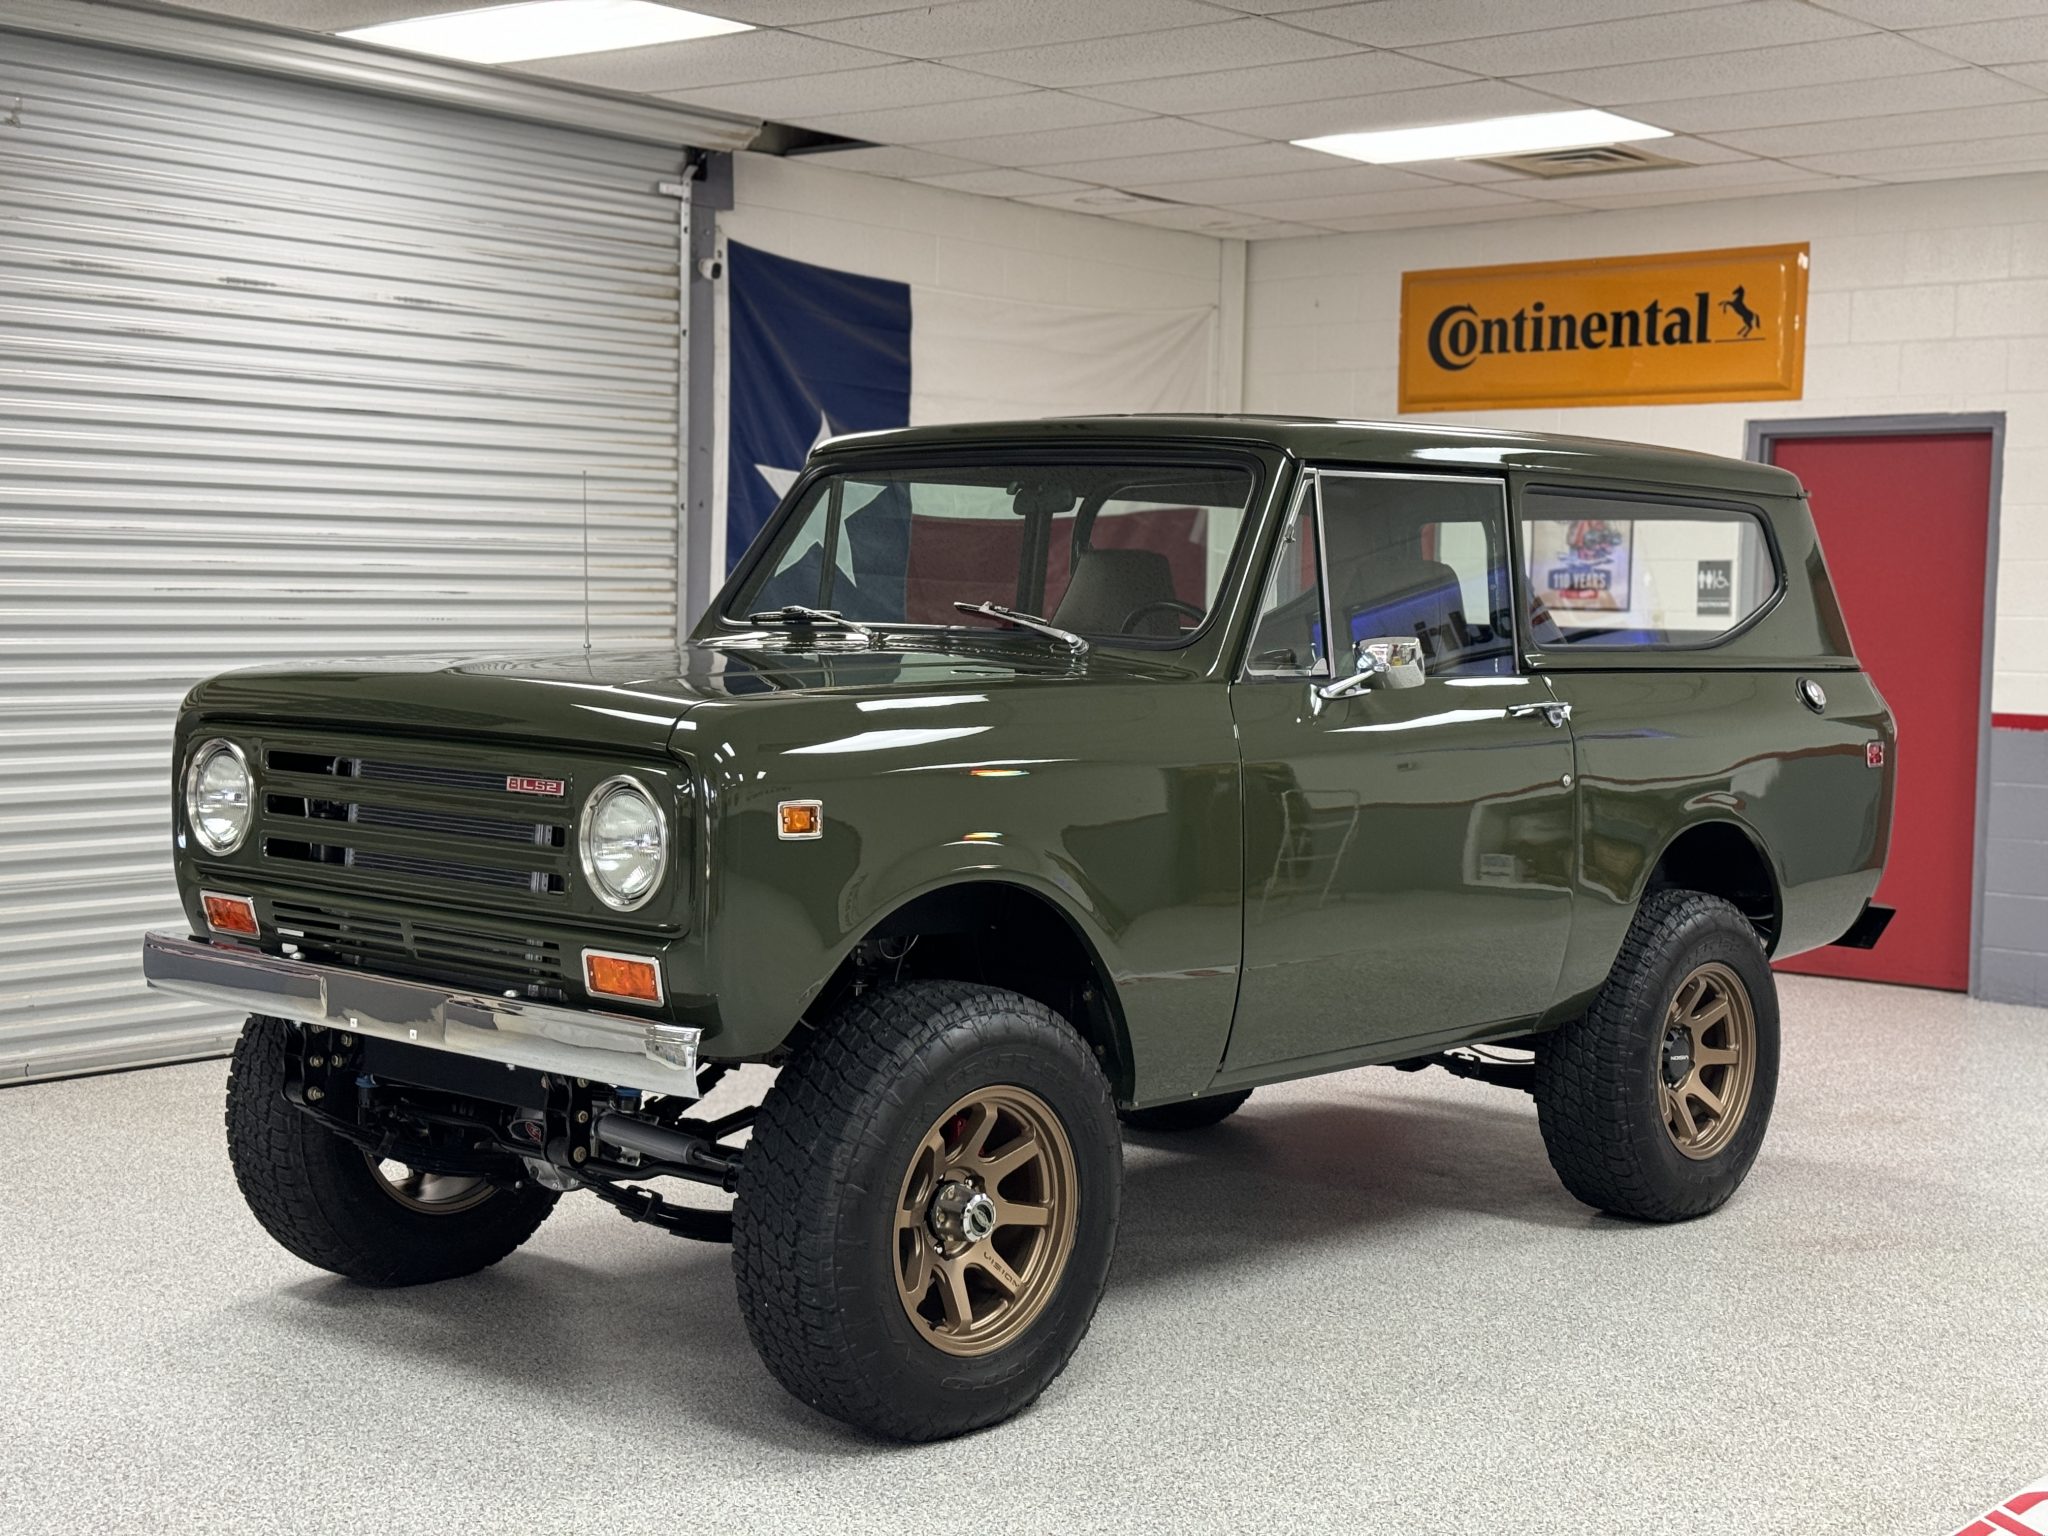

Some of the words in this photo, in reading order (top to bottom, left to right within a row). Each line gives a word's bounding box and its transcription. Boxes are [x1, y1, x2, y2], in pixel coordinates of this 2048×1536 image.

[1428, 292, 1711, 371] Continental
[1573, 573, 1606, 589] YEARS
[523, 780, 557, 792] LS2
